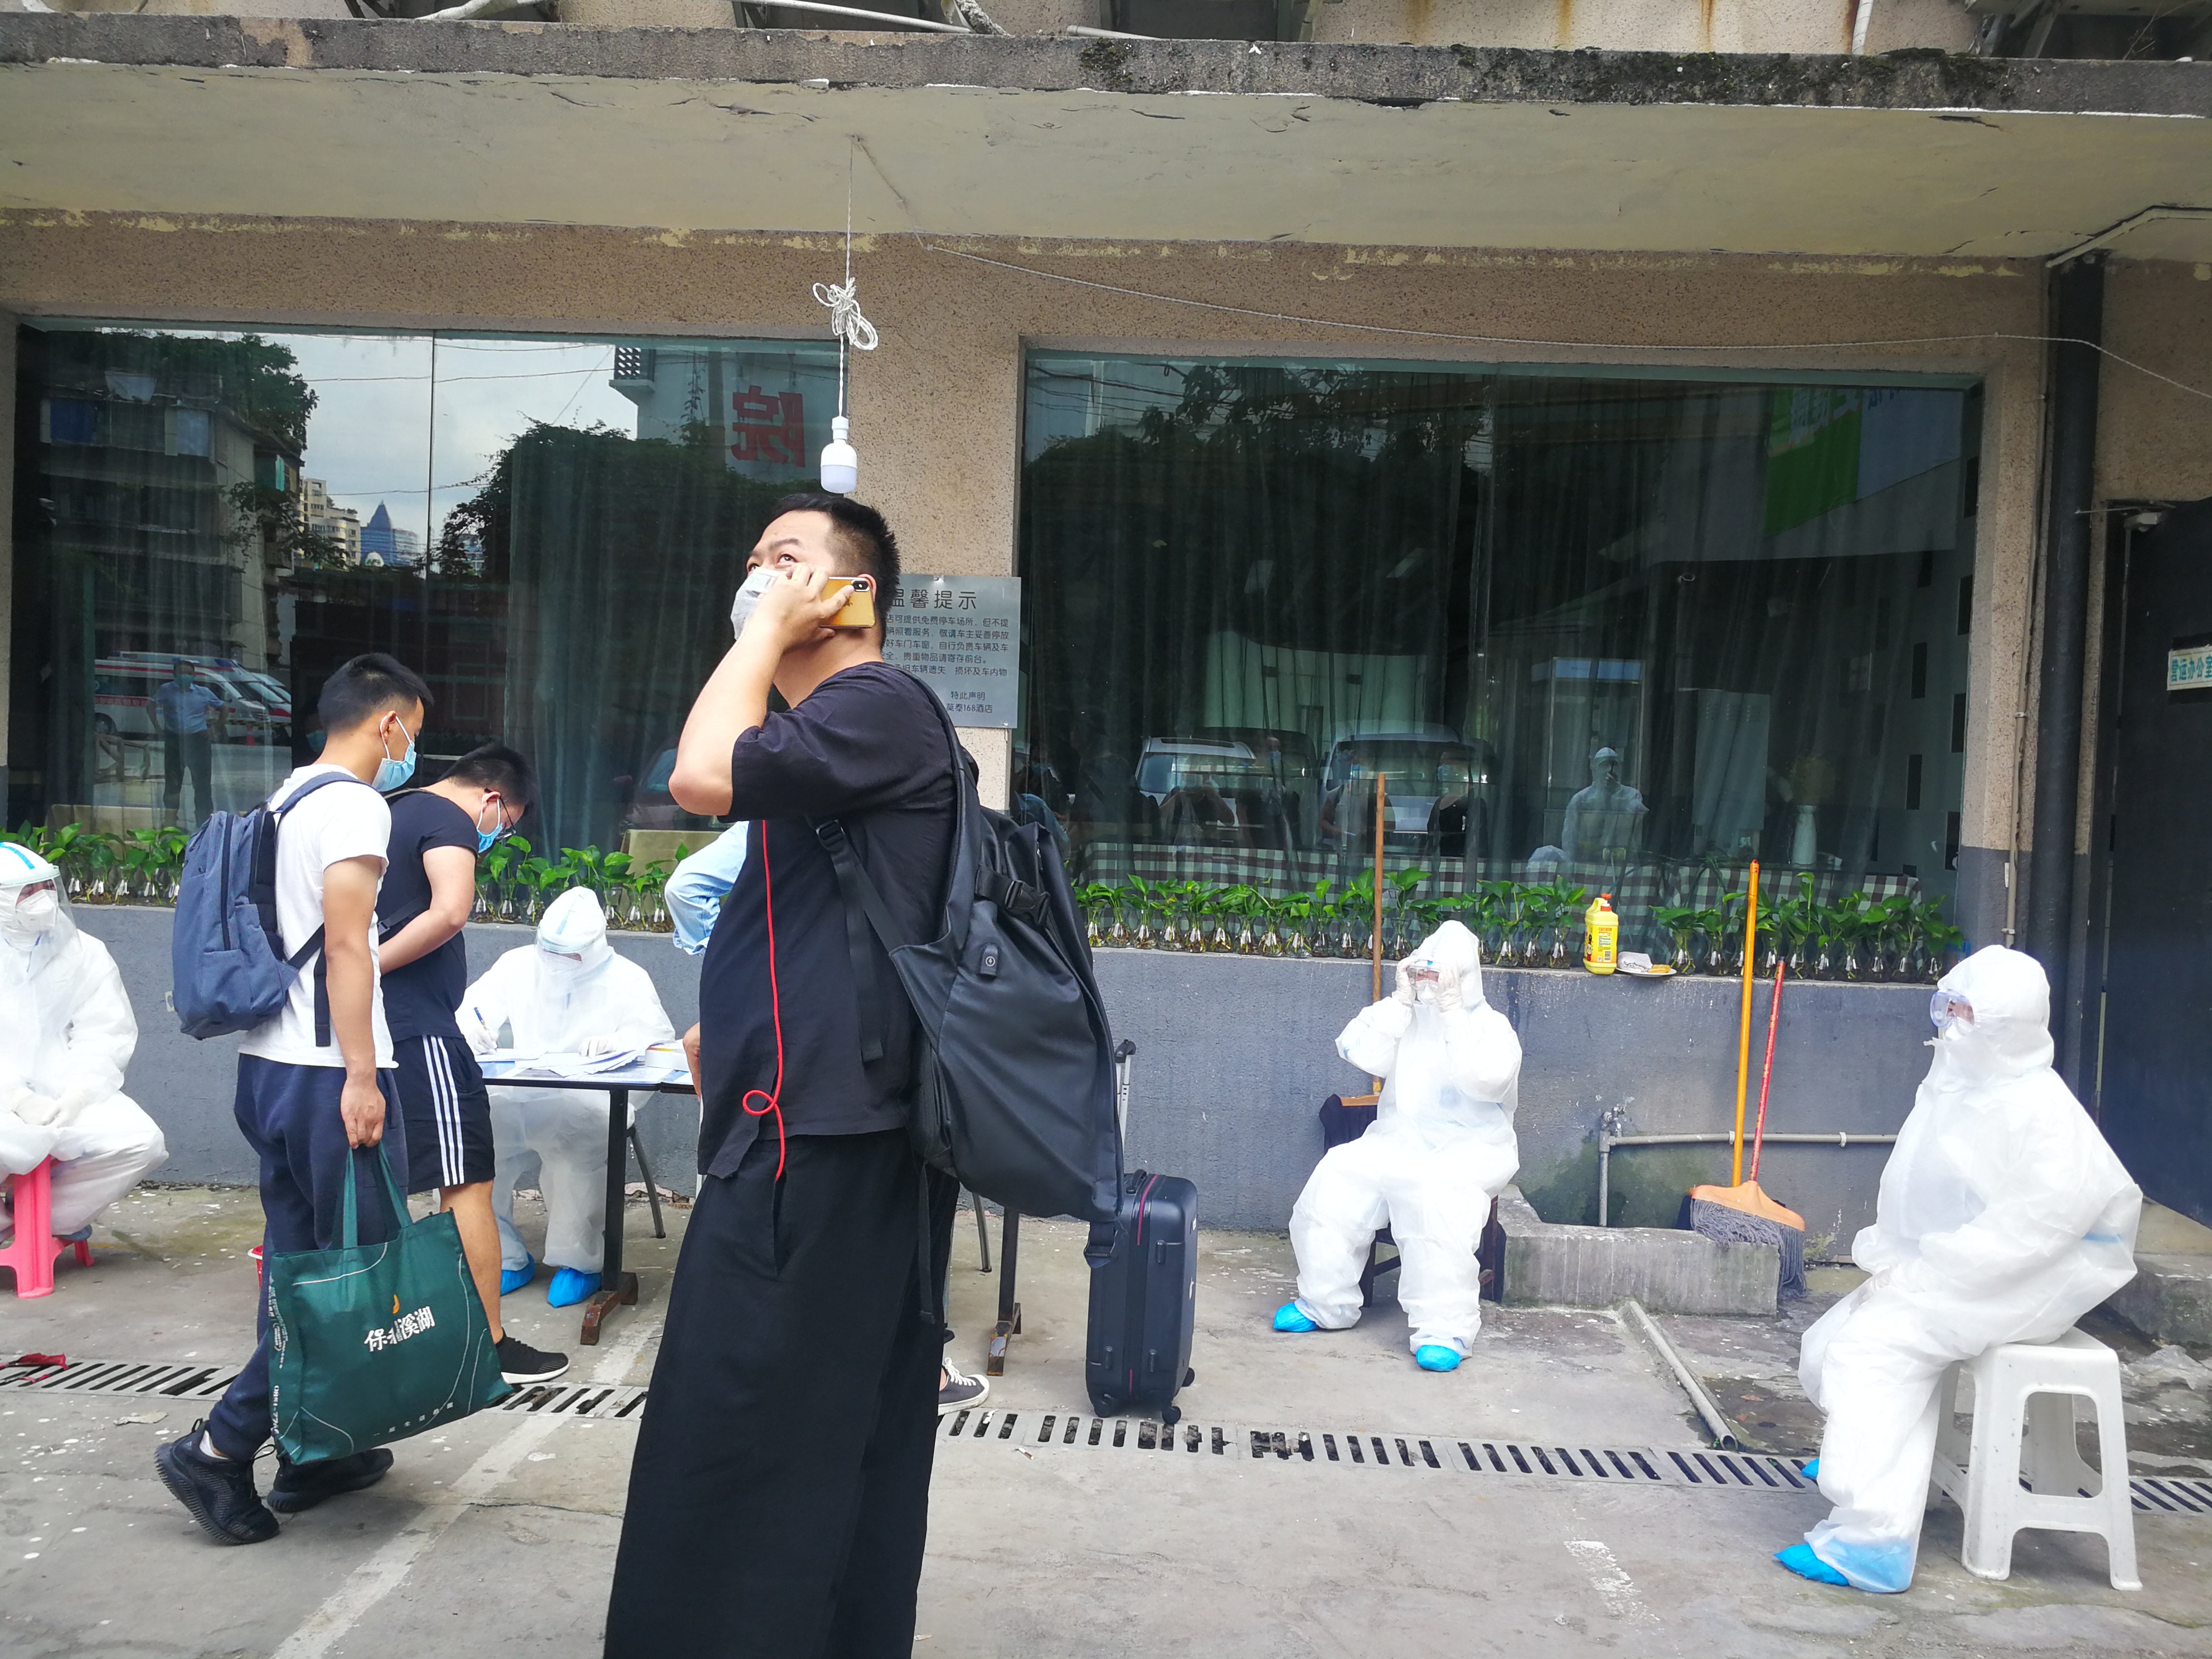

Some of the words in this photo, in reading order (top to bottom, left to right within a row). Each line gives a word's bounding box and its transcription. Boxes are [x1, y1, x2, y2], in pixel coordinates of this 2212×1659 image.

[950, 691, 985, 700] 特此声明
[947, 703, 992, 713] 莫泰168酒店
